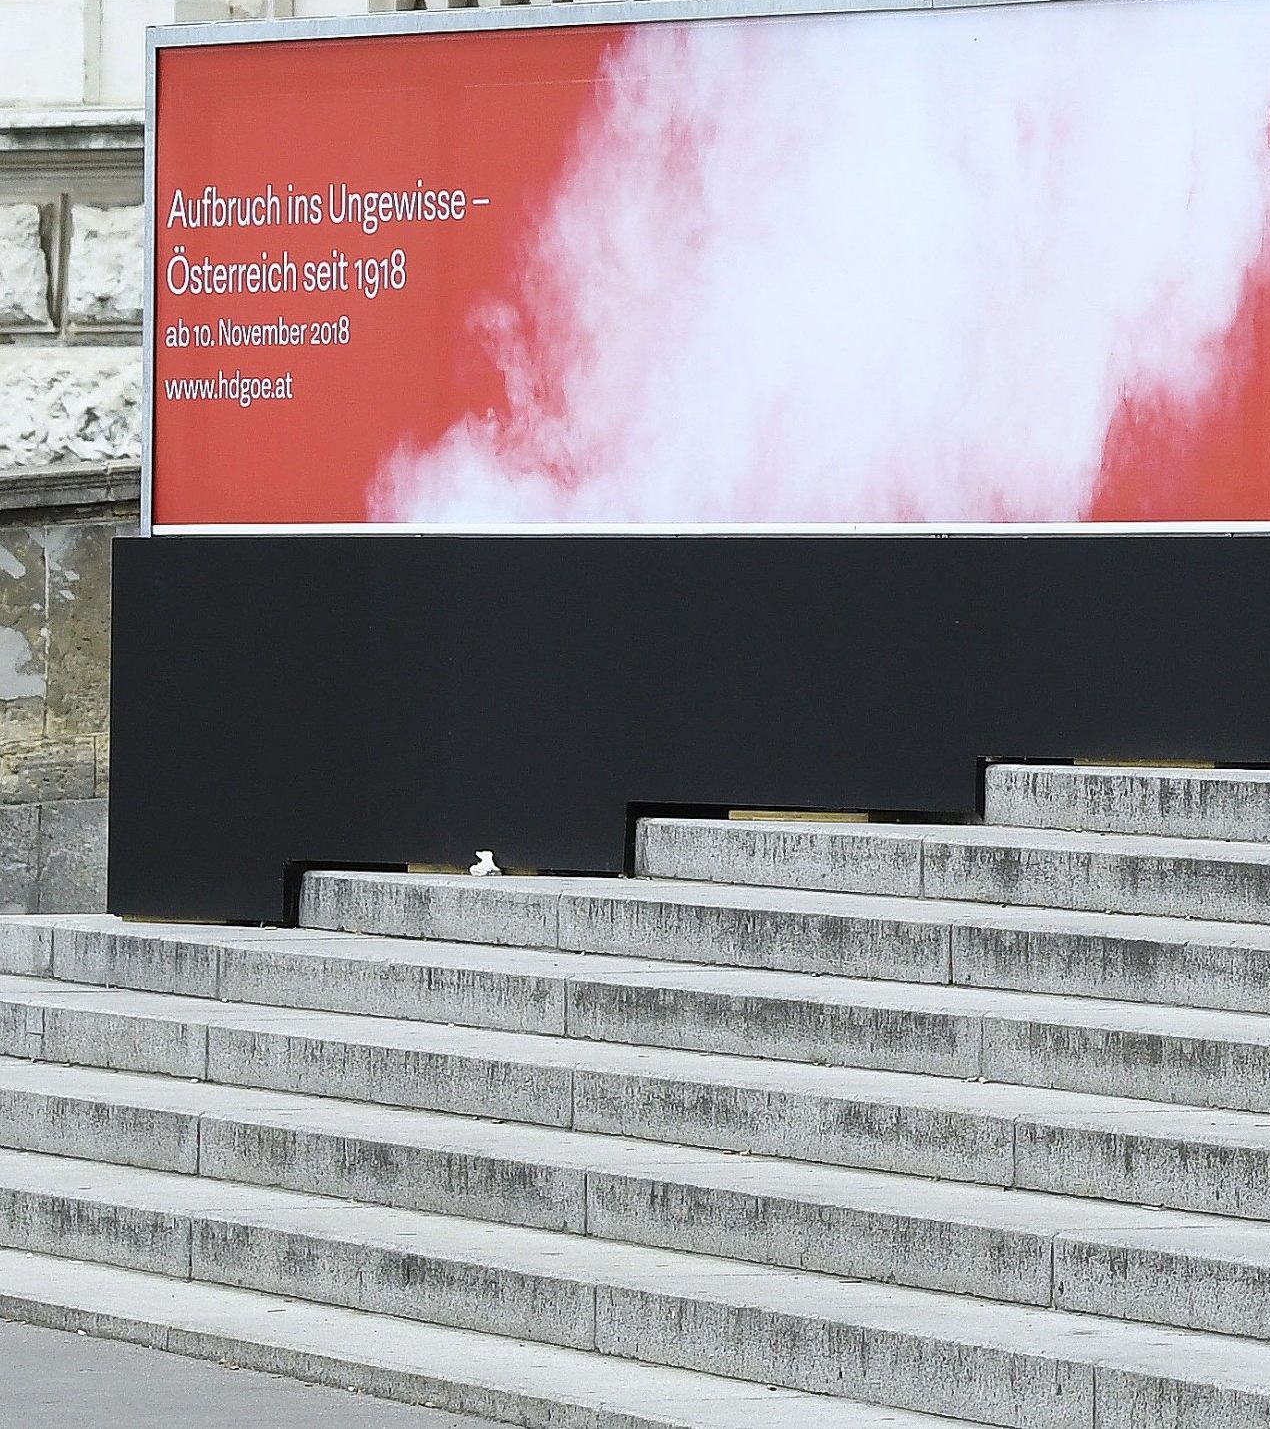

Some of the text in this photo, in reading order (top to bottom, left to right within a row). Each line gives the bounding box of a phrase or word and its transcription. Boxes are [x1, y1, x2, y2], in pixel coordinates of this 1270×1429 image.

[167, 184, 280, 228] Aufbruch
[288, 184, 323, 225] ins
[329, 179, 466, 235] Ungewisse
[167, 245, 406, 299] Österreich seit 1918
[165, 315, 350, 347] ab 10. November 2018
[164, 369, 293, 408] www.hdgoe.at
